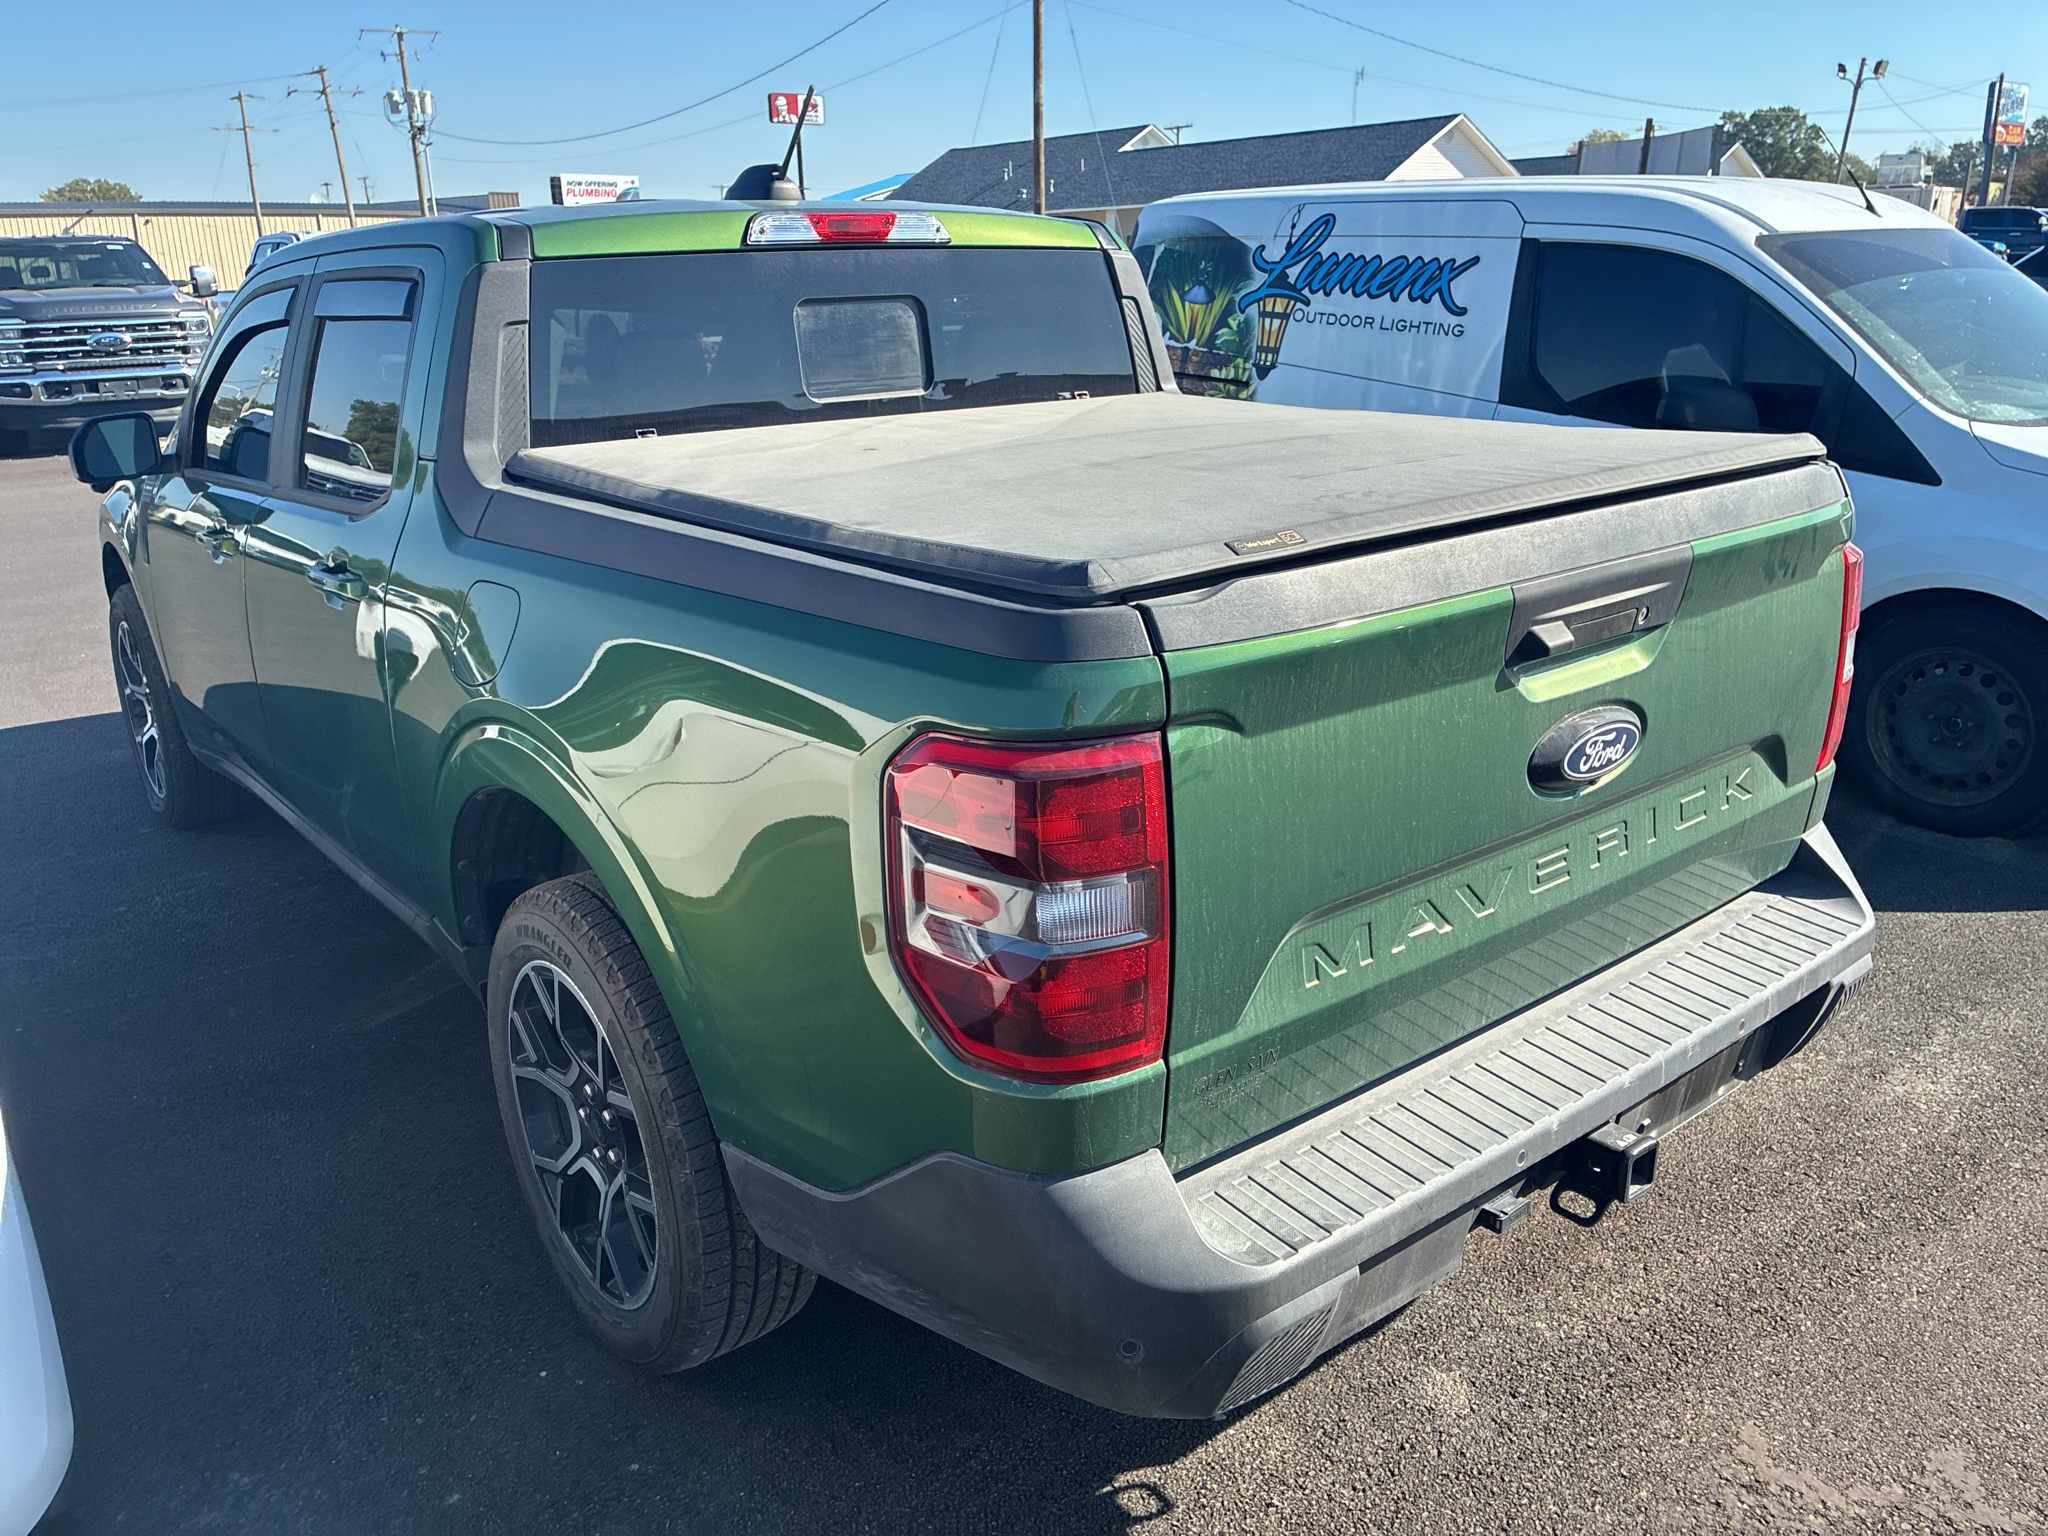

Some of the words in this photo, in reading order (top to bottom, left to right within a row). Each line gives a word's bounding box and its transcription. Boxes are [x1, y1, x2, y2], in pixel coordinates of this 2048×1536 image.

[566, 188, 618, 198] PLUMBING
[584, 180, 618, 188] OFFERING
[1238, 213, 1480, 317] Lumenx
[1292, 307, 1375, 330] OUTDOOR
[1379, 315, 1465, 337] LIGHTING
[1579, 731, 1627, 772] Ford
[1300, 766, 1754, 988] MAVERICK
[515, 924, 574, 971] WRANGLER
[1194, 1063, 1238, 1096] GLEN
[1244, 1045, 1280, 1076] SAIN
